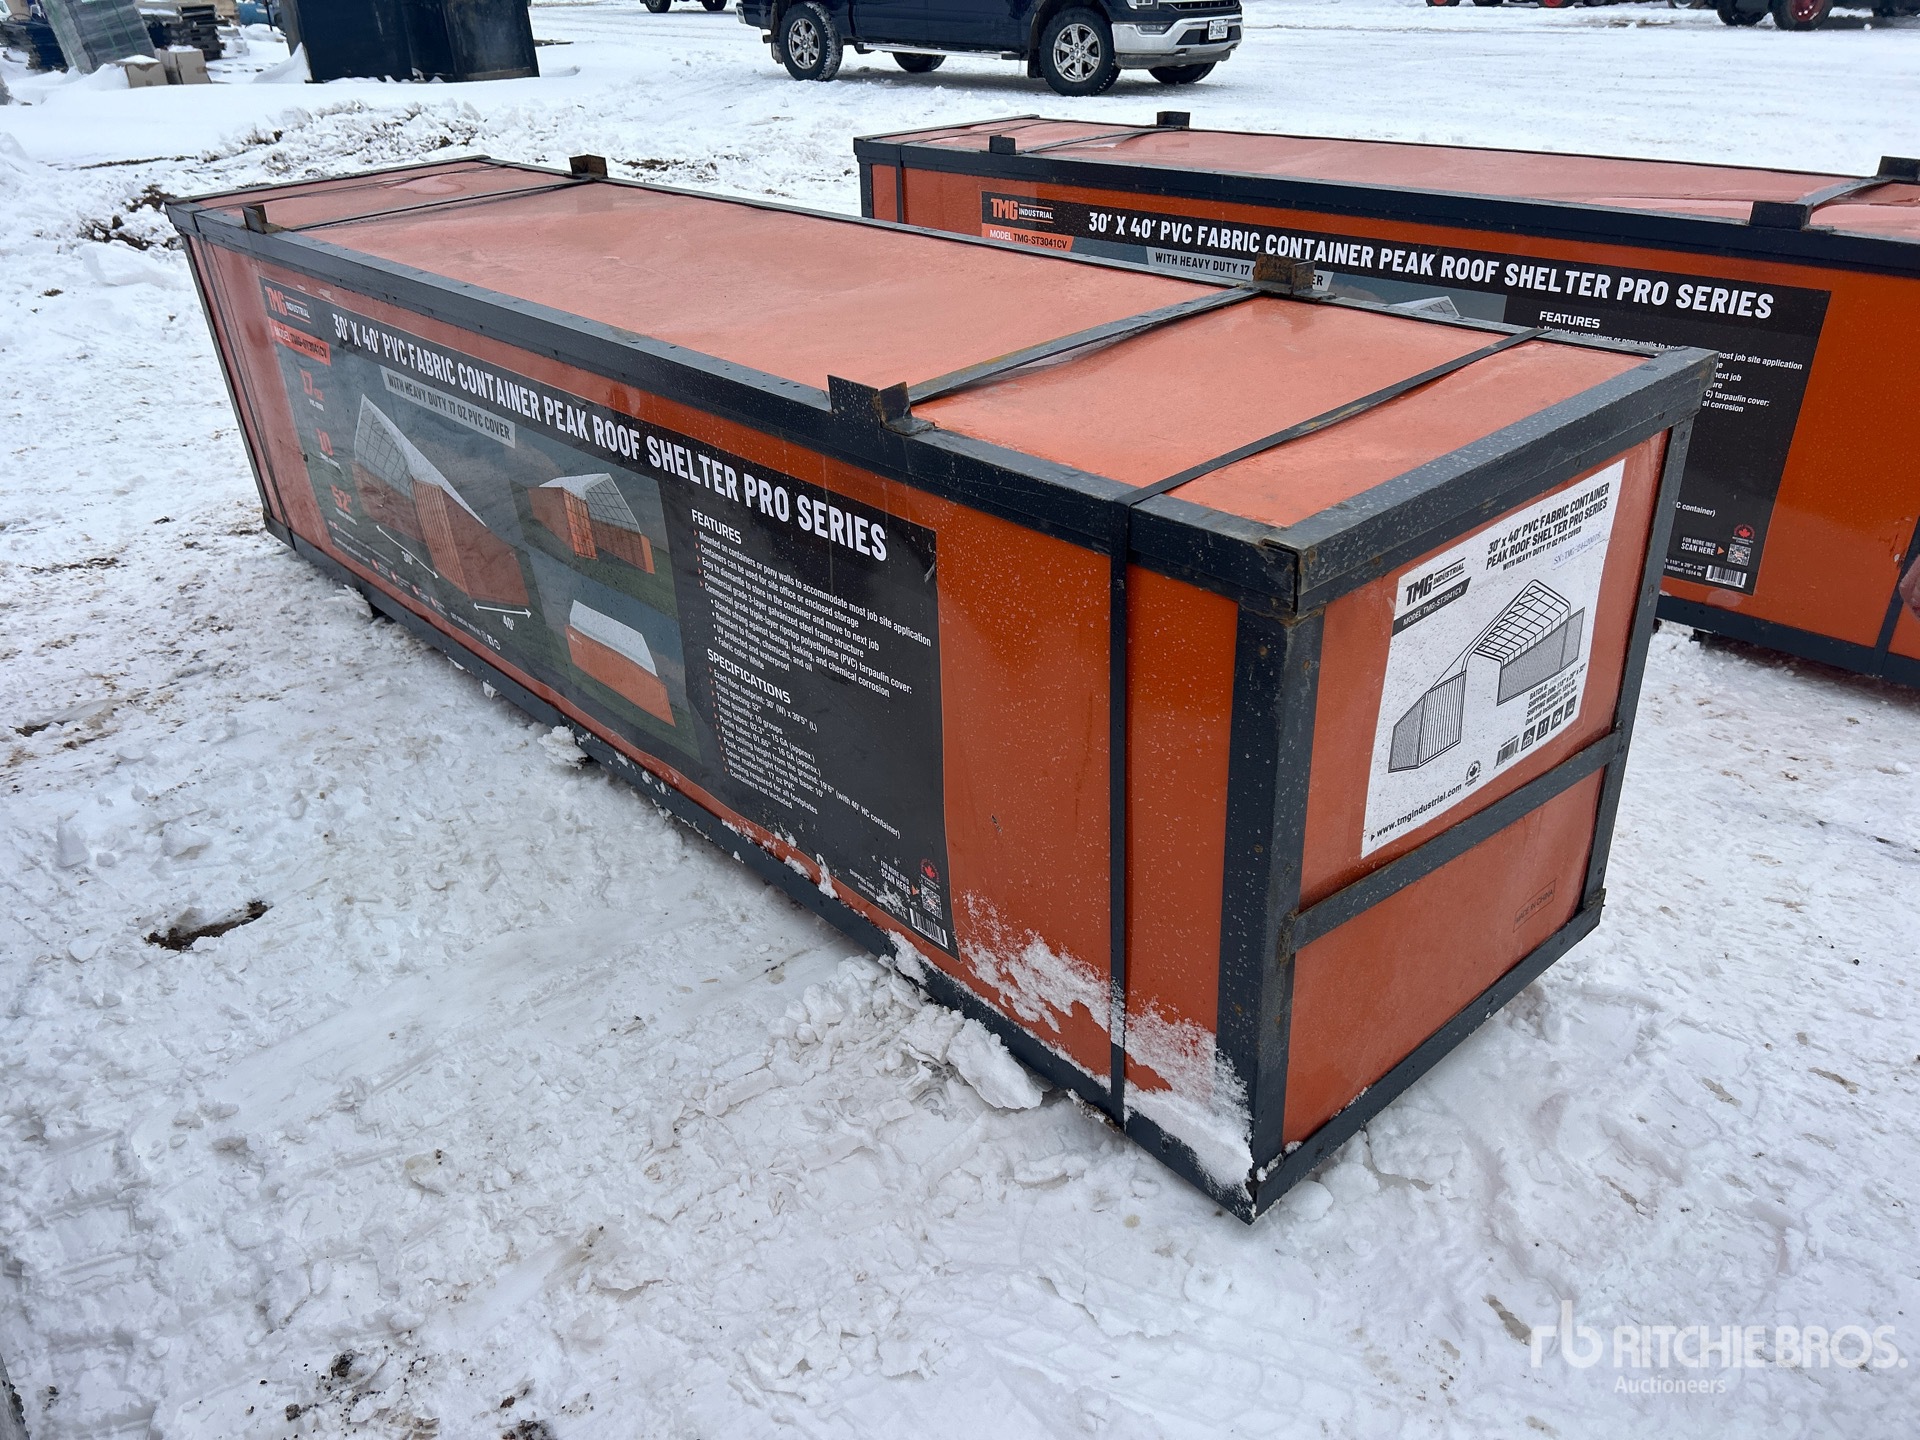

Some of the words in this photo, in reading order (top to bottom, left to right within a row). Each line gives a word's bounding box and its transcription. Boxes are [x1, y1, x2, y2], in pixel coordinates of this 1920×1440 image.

[991, 198, 1018, 220] TMG
[1019, 208, 1053, 219] INDUSTRIAL
[990, 230, 1012, 241] MODEL
[1014, 233, 1067, 248] TMG-ST3041CV
[1089, 212, 1112, 233] 30'
[1116, 215, 1126, 235] X
[1131, 218, 1156, 238] 40'
[1160, 220, 1192, 244] PVC
[1197, 226, 1260, 253] FABRIC
[1265, 234, 1372, 268] CONTAINER
[1379, 248, 1436, 276] PEAK
[1441, 256, 1500, 283] ROOF
[1504, 263, 1611, 299] SHELTER
[1617, 277, 1669, 306] PRO
[1675, 284, 1774, 319] SERIES
[1155, 252, 1178, 265] WITH
[1180, 256, 1210, 270] HEAVY
[1213, 261, 1237, 274] DUTY
[1240, 264, 1250, 275] 17
[265, 286, 287, 316] TMG
[285, 302, 310, 318] INDUSTRIAL
[1540, 311, 1600, 329] FEATURES
[1730, 373, 1741, 381] job
[1734, 353, 1746, 361] job
[1747, 355, 1760, 363] site
[1762, 358, 1802, 370] application
[387, 374, 404, 393] WITH
[405, 380, 426, 402] HEAVY
[428, 392, 447, 411] DUTY
[448, 400, 455, 415] 17
[458, 406, 467, 420] OZ
[468, 409, 483, 427] PVC
[485, 417, 510, 440] COVER
[1711, 402, 1743, 412] corrosion
[1715, 392, 1746, 403] tarpaulin
[1747, 397, 1770, 406] cover:
[332, 313, 348, 341] 30'
[350, 320, 361, 347] X
[362, 325, 379, 354] 40'
[382, 332, 407, 365] PVC
[408, 343, 456, 385] FABRIC
[457, 362, 541, 422] CONTAINER
[543, 396, 590, 441] PEAK
[592, 415, 640, 460] ROOF
[646, 436, 739, 502] SHELTER
[744, 473, 790, 522] PRO
[796, 494, 887, 562] SERIES
[691, 508, 742, 545] FEATURES
[1522, 519, 1539, 537] PVC
[1540, 504, 1569, 528] FABRIC
[1570, 482, 1610, 513] CONTAINER
[1682, 504, 1715, 517] container)
[1486, 549, 1509, 570] PEAK
[1509, 537, 1531, 557] ROOF
[1532, 519, 1568, 547] SHELTER
[1568, 512, 1583, 529] PRO
[1584, 497, 1608, 520] SERIES
[1503, 559, 1515, 570] WITH
[1516, 551, 1532, 564] HEAVY
[1532, 545, 1545, 556] DUTY
[1558, 534, 1567, 544] PVC
[1567, 526, 1582, 541] COVER
[1681, 543, 1698, 552] SCAN
[1698, 546, 1715, 555] HERE
[698, 530, 721, 550] Mounted
[728, 547, 756, 567] containers
[756, 561, 763, 570] or
[763, 564, 777, 579] pony
[777, 571, 794, 586] walls
[794, 578, 802, 589] to
[802, 582, 847, 609] accommodate
[848, 602, 866, 617] most
[865, 608, 877, 624] job
[879, 615, 892, 629] site
[893, 622, 931, 647] application
[700, 543, 726, 565] Containers
[727, 559, 737, 571] can
[736, 562, 744, 574] be
[744, 568, 758, 581] used
[758, 574, 767, 586] for
[766, 578, 778, 592] site
[778, 585, 796, 600] office
[797, 594, 804, 604] or
[804, 596, 833, 617] enclosed
[833, 609, 859, 629] storage
[1406, 574, 1434, 606] TMG
[1433, 563, 1464, 585] INDUSTRIAL
[701, 556, 713, 572] Easy
[713, 563, 720, 574] to
[719, 566, 745, 587] dismantle
[744, 580, 751, 591] to
[751, 584, 766, 598] store
[765, 590, 772, 602] in
[772, 594, 783, 607] the
[783, 601, 811, 620] container
[812, 614, 824, 626] and
[824, 620, 843, 635] move
[843, 627, 851, 639] to
[852, 632, 867, 646] next
[867, 637, 879, 652] job
[702, 569, 732, 592] Commercial
[732, 587, 747, 601] grade
[747, 594, 767, 612] 3-layer
[767, 606, 798, 627] galvanized
[798, 620, 814, 635] steel
[814, 626, 833, 644] frame
[833, 637, 864, 659] structure
[1403, 610, 1421, 626] MODEL
[707, 647, 791, 705] SPECIFICATIONS
[778, 623, 800, 641] ripstop
[800, 635, 839, 660] polyethylene
[840, 652, 858, 671] (PVC)
[859, 661, 890, 685] tarpaulin
[890, 677, 912, 695] cover:
[828, 660, 857, 682] chemical
[858, 675, 890, 698] corrosion
[870, 813, 900, 840] container)
[1377, 783, 1462, 837] www.tmgindustrial.com
